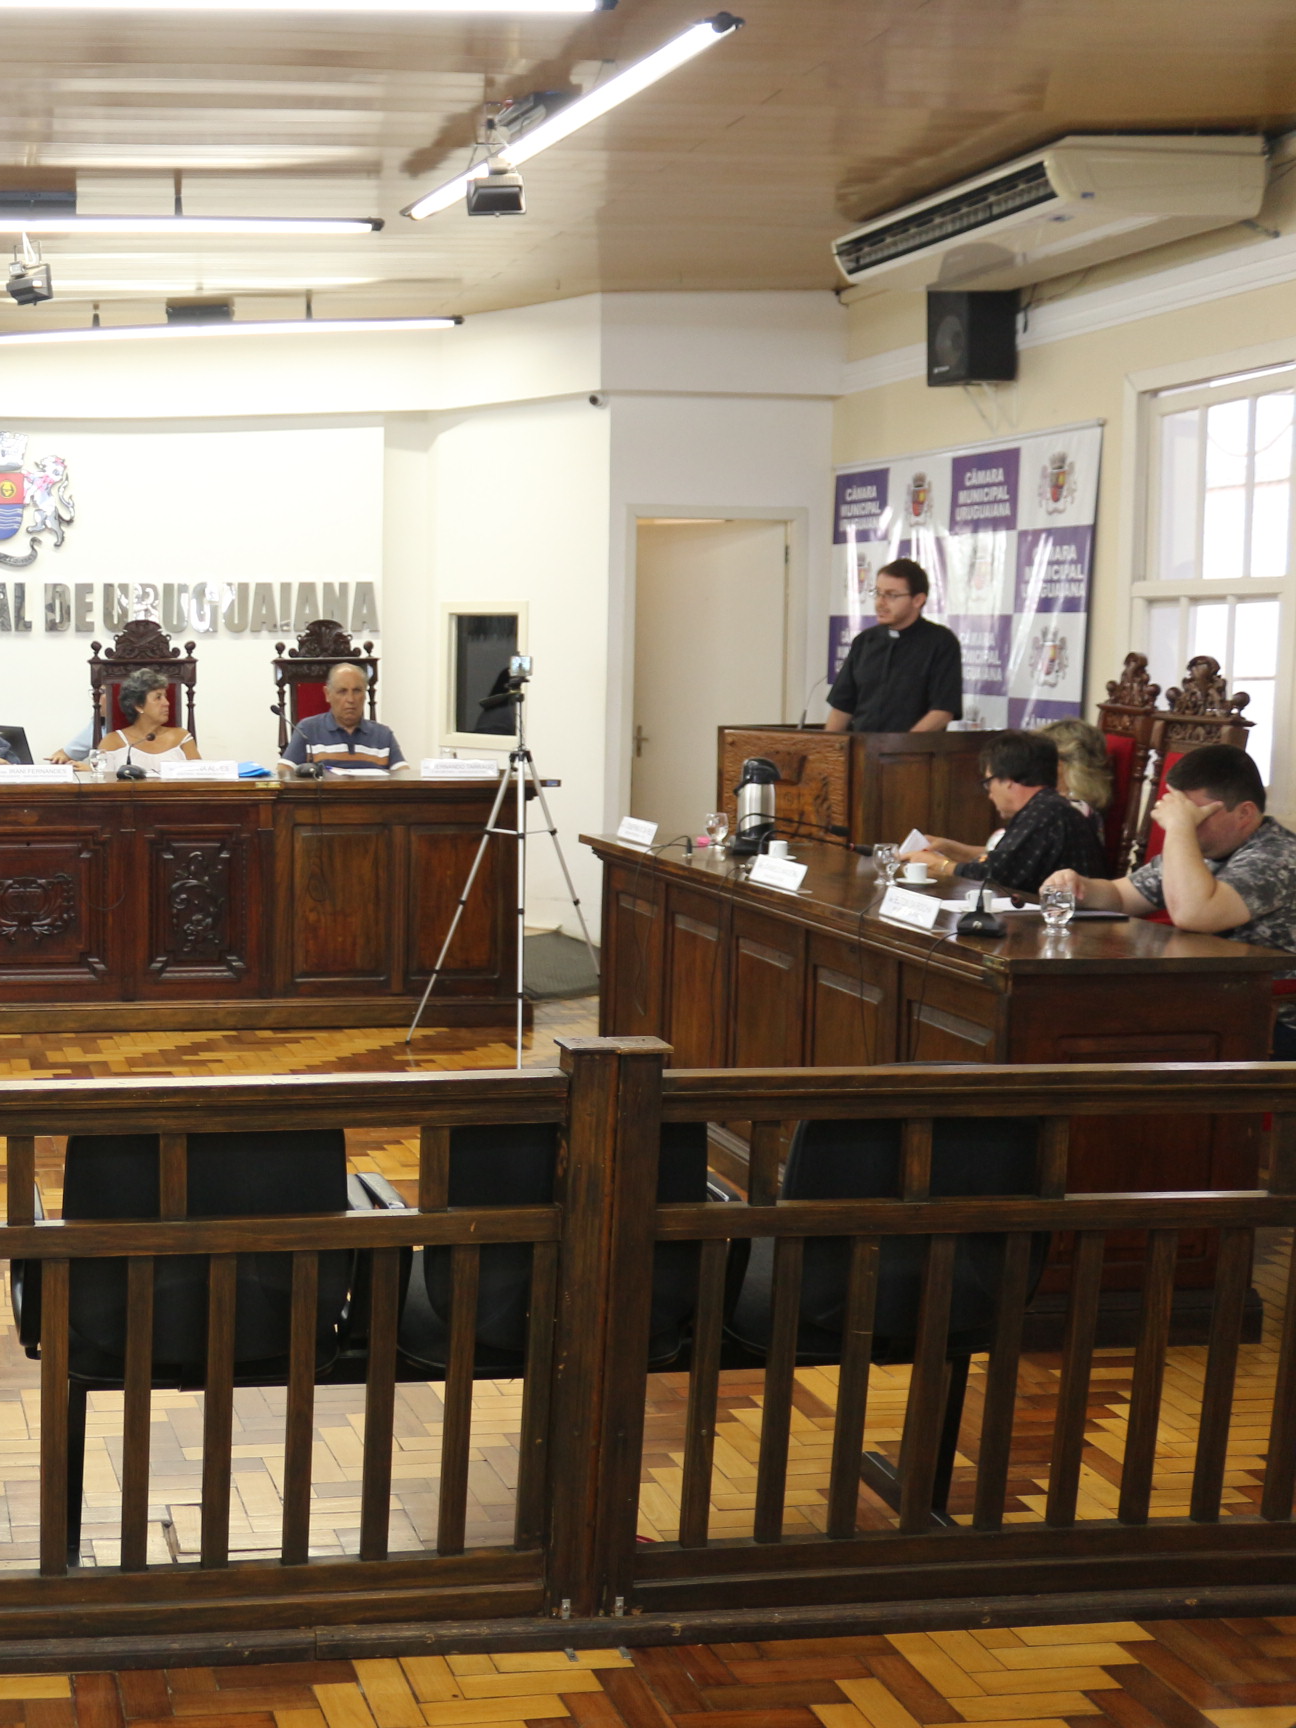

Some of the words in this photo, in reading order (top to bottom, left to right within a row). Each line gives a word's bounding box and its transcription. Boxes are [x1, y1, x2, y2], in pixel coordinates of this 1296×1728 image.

[965, 468, 1004, 487] CÂMARA
[958, 486, 1010, 505] MUNICIPAL
[44, 583, 94, 632] DE
